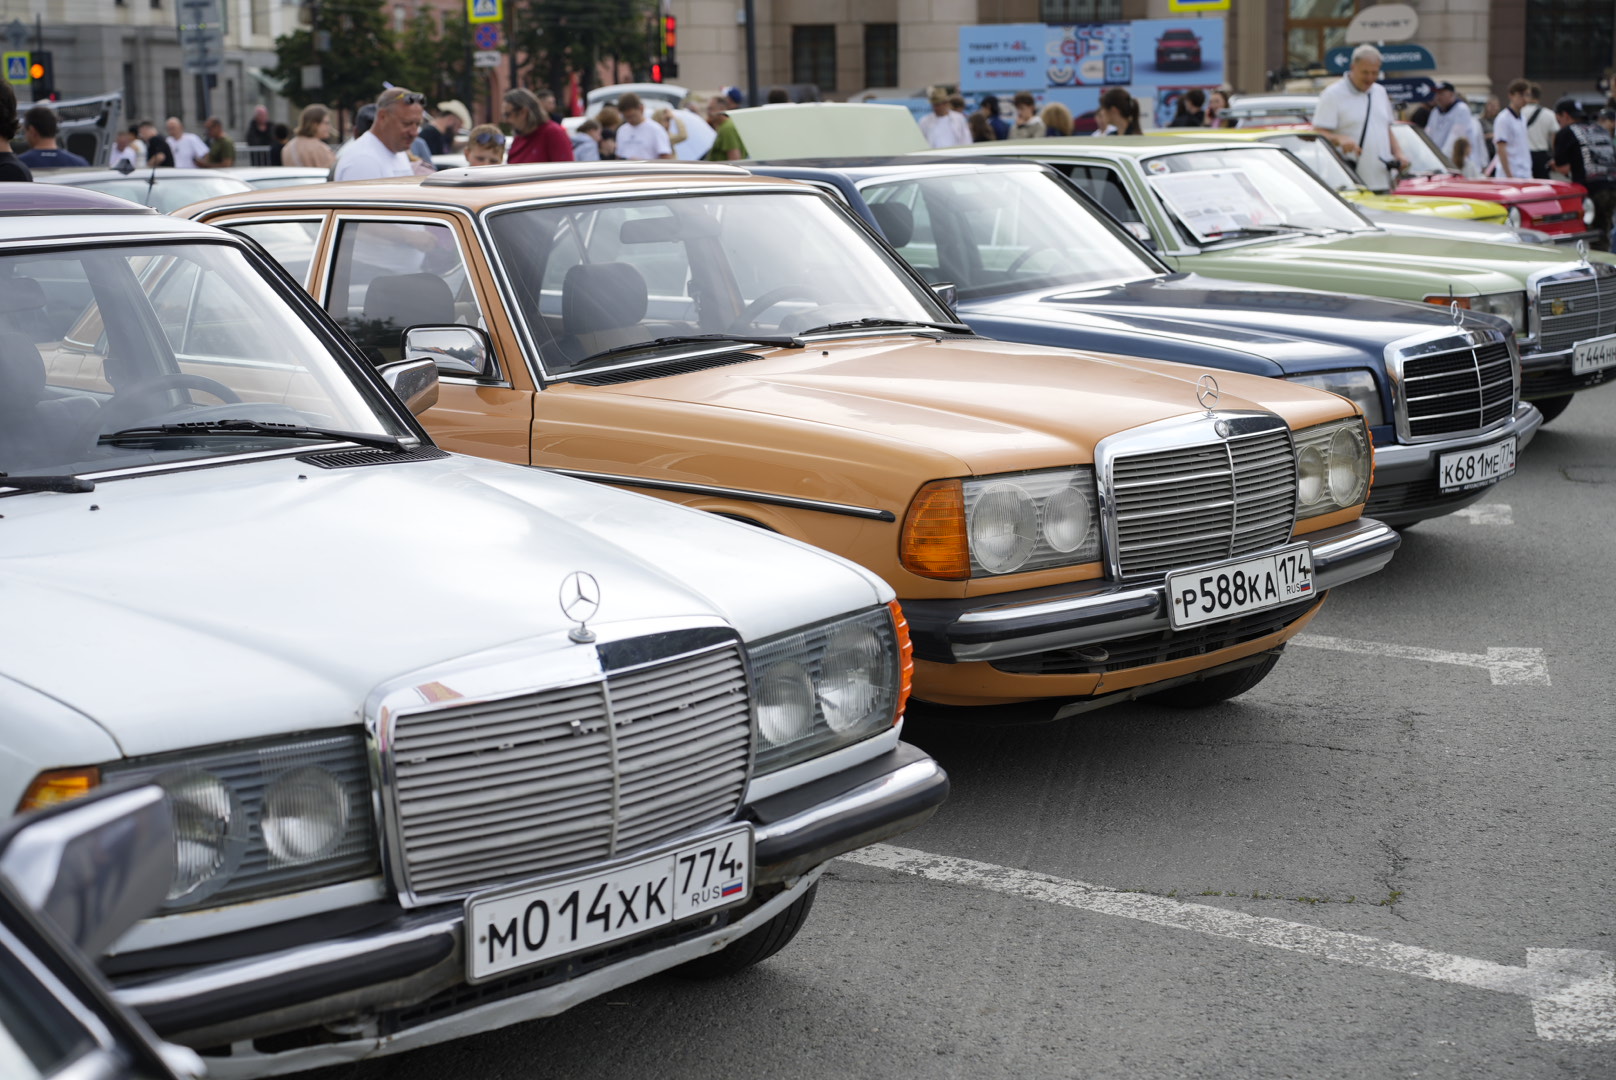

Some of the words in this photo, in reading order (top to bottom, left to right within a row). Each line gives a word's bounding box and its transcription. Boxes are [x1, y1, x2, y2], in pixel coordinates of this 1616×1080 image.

[1445, 453, 1499, 484] К681МЕ
[1182, 570, 1277, 618] Р588КА
[1279, 553, 1307, 584] 174
[1287, 583, 1300, 595] RUS
[487, 876, 669, 964] М014ХК
[679, 841, 736, 895] 774
[691, 885, 720, 907] RUS
